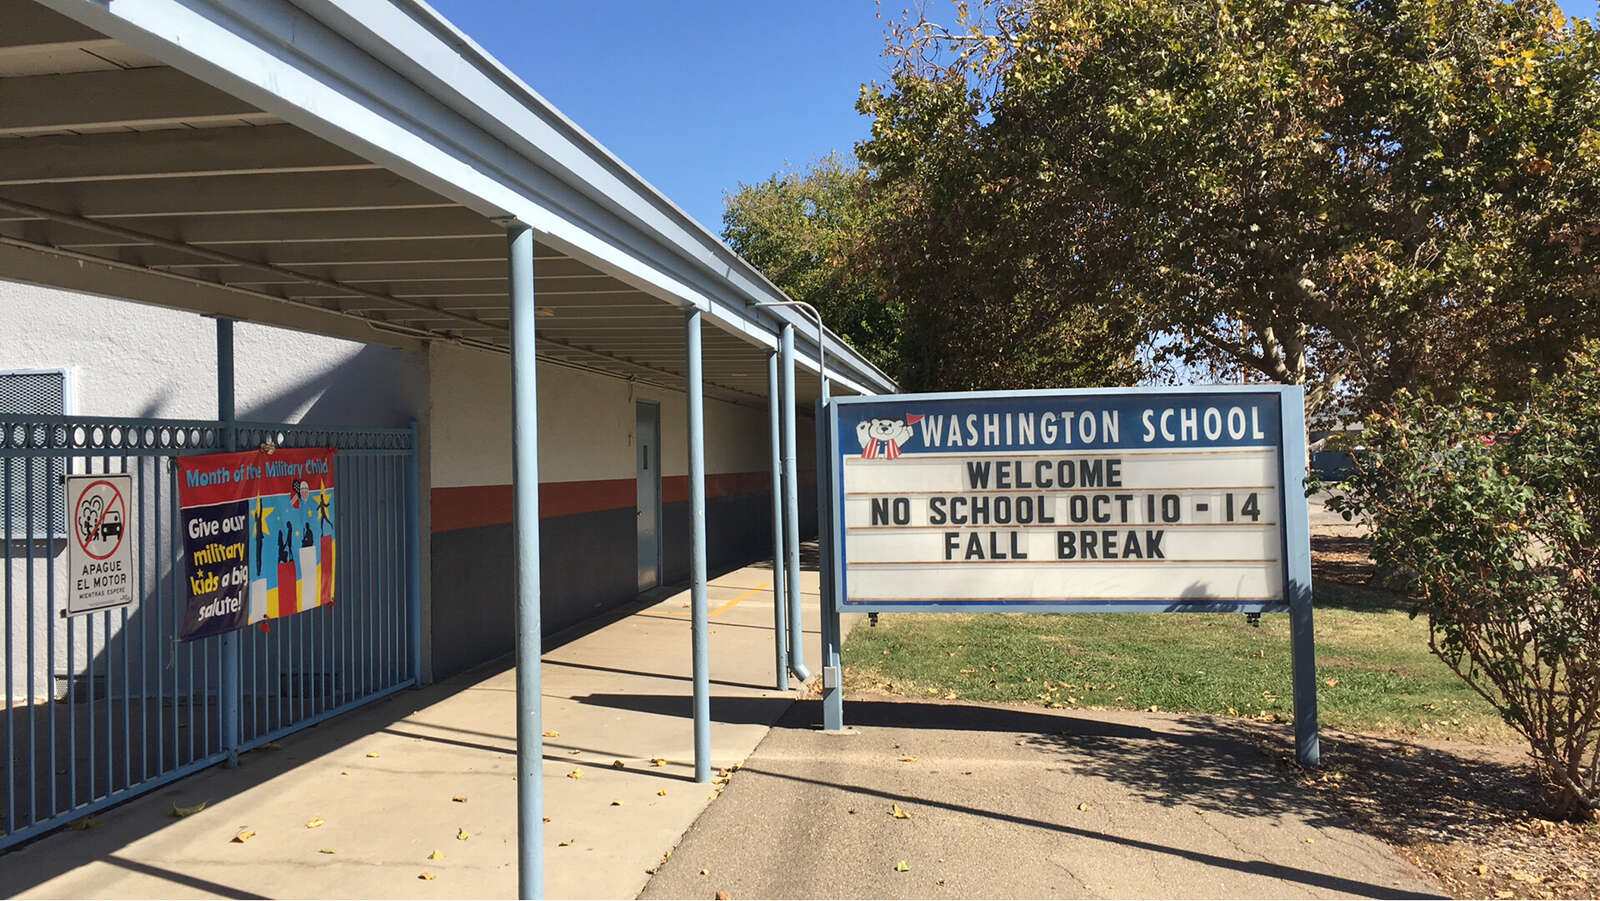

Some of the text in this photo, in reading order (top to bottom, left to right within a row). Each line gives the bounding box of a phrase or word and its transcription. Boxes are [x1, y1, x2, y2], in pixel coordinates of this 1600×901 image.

[920, 406, 1265, 447] WASHINGTON SCHOOL
[186, 469, 230, 488] Month
[233, 465, 247, 482] of
[265, 460, 302, 479] Military
[305, 458, 328, 475] Child
[967, 459, 1122, 489] WELCOME
[871, 497, 910, 525] NO
[930, 496, 1054, 525] SCHOOL
[1070, 494, 1133, 523] OCT
[1148, 494, 1181, 522] 10
[1226, 492, 1260, 522] 14
[188, 515, 245, 539] Give our
[194, 543, 245, 566] military
[945, 530, 1165, 560] FALL BREAK
[77, 574, 127, 590] EL MOTOR
[82, 561, 122, 575] APAGUE
[190, 565, 248, 595] kids a big
[198, 591, 242, 621] salute!
